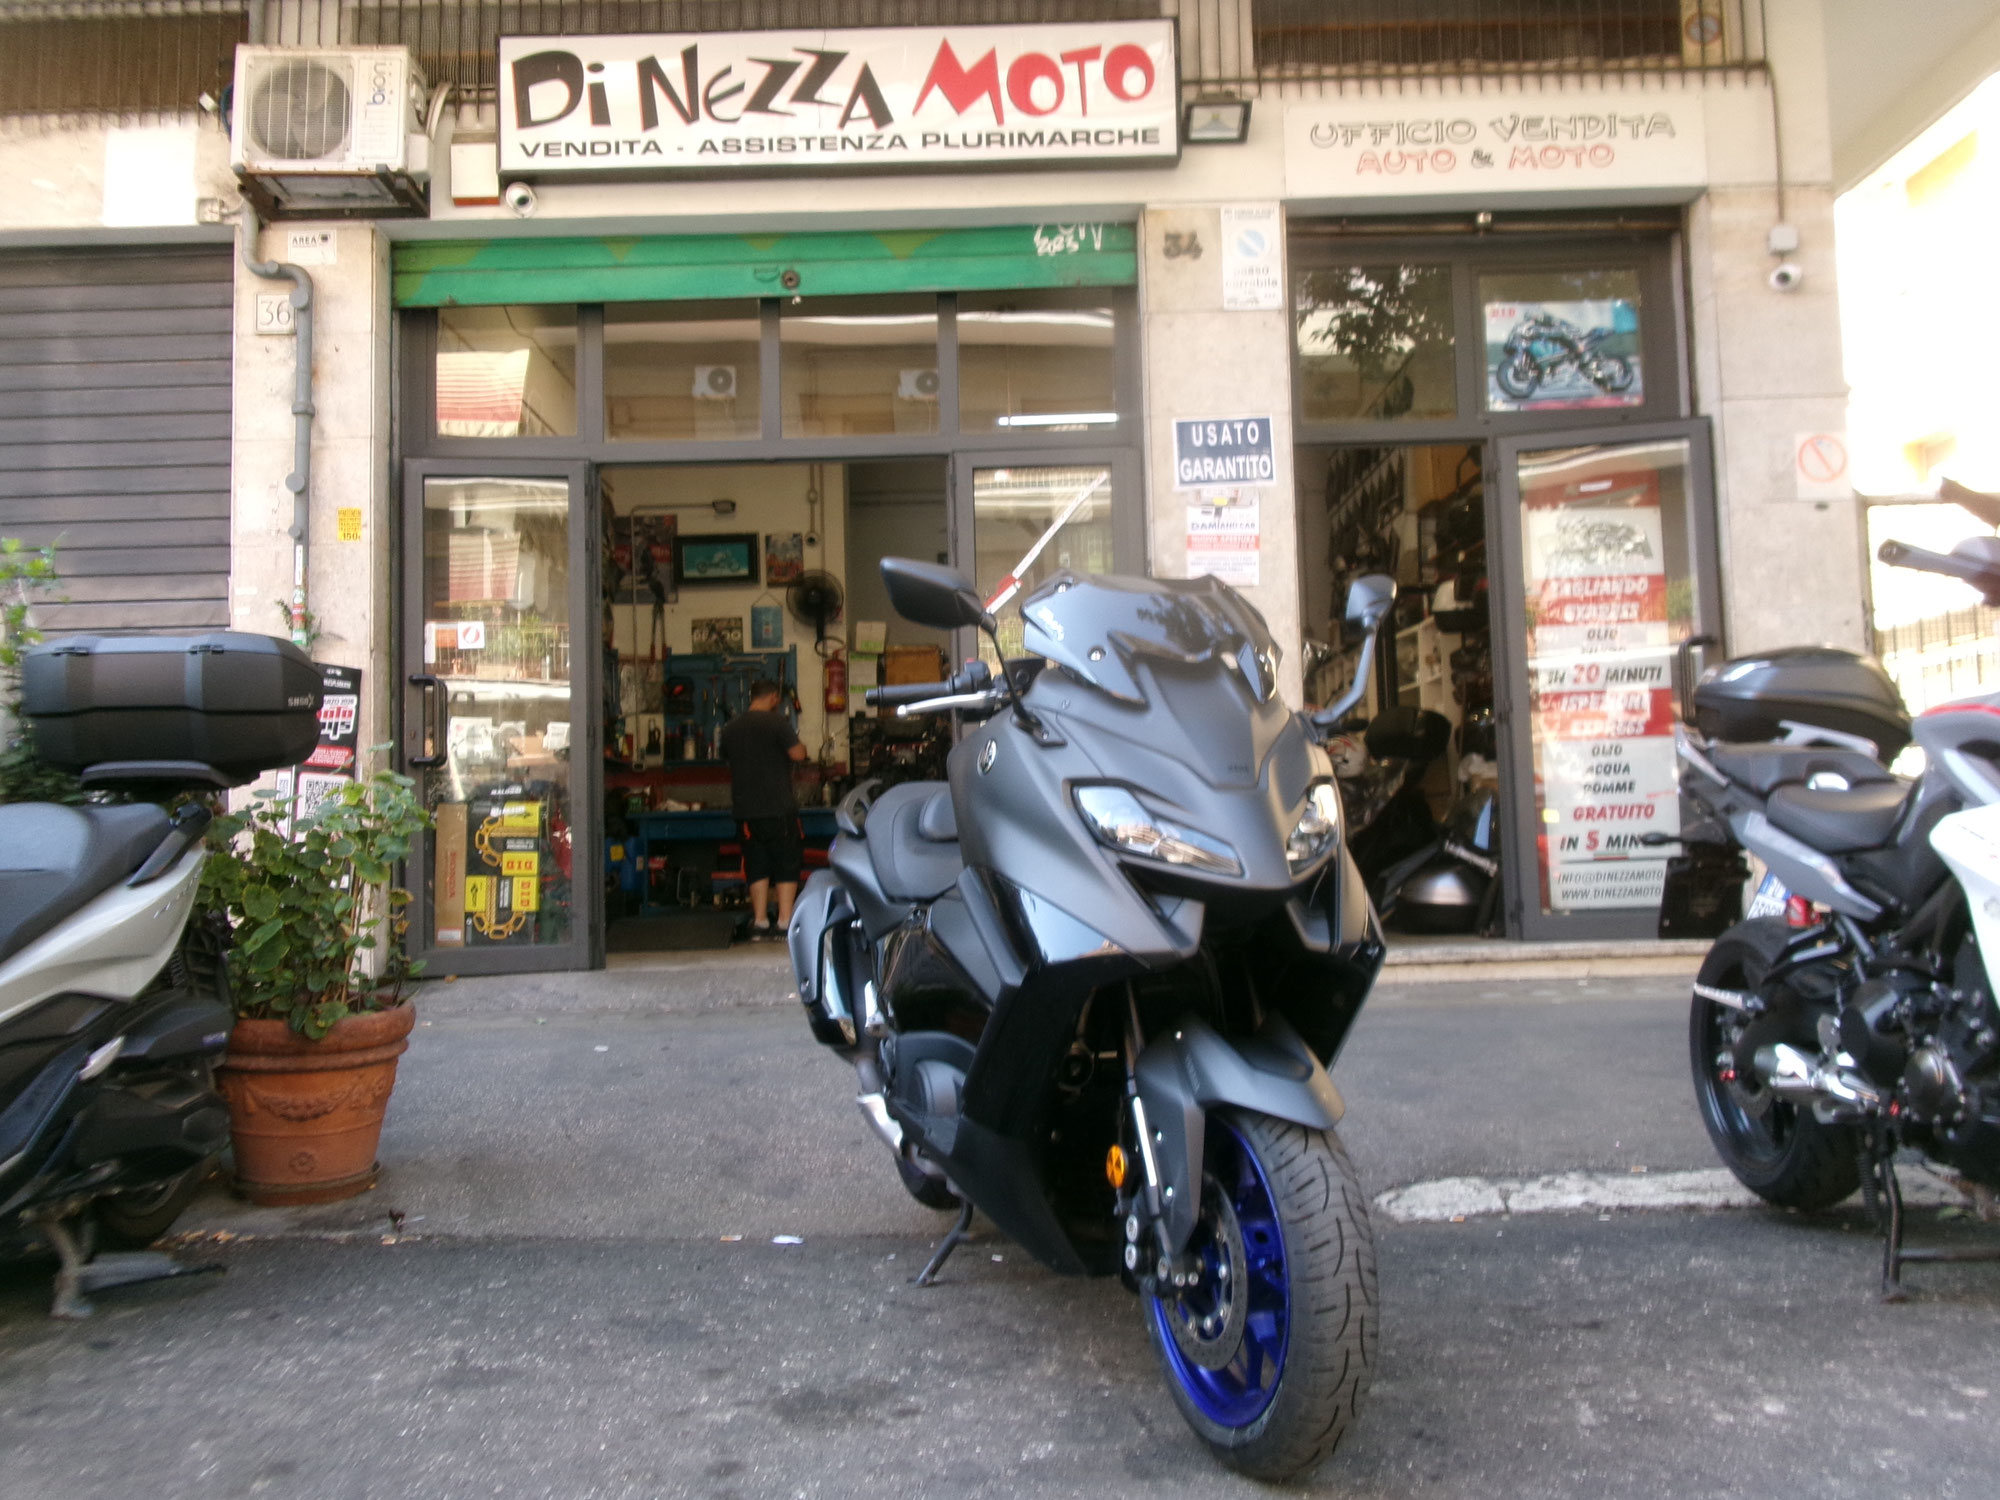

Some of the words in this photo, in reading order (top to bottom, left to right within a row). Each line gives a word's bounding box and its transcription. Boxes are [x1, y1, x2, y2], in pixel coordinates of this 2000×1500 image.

[912, 37, 1155, 126] MOTO
[519, 140, 663, 158] VENDITA
[697, 134, 909, 155] ASSISTENZA
[921, 127, 1160, 150] PLURIMARCHE
[1310, 117, 1477, 148] UFFICIO
[1489, 111, 1677, 142] VENDITA
[1356, 148, 1457, 175] AUTO
[1471, 148, 1494, 168] &
[1509, 144, 1615, 171] MOTO
[1163, 229, 1203, 261] 34
[259, 300, 291, 327] 36
[1192, 421, 1260, 447] USATO
[1180, 454, 1271, 482] GARANTITO
[1587, 628, 1618, 640] OLIO
[1573, 663, 1600, 684] 20
[1605, 666, 1662, 682] MINUTI
[1592, 744, 1623, 757] OLIO
[1586, 762, 1631, 776] ACQUA
[1573, 804, 1655, 822] GRATUITO
[1560, 834, 1579, 851] IN
[1586, 830, 1600, 850] 5
